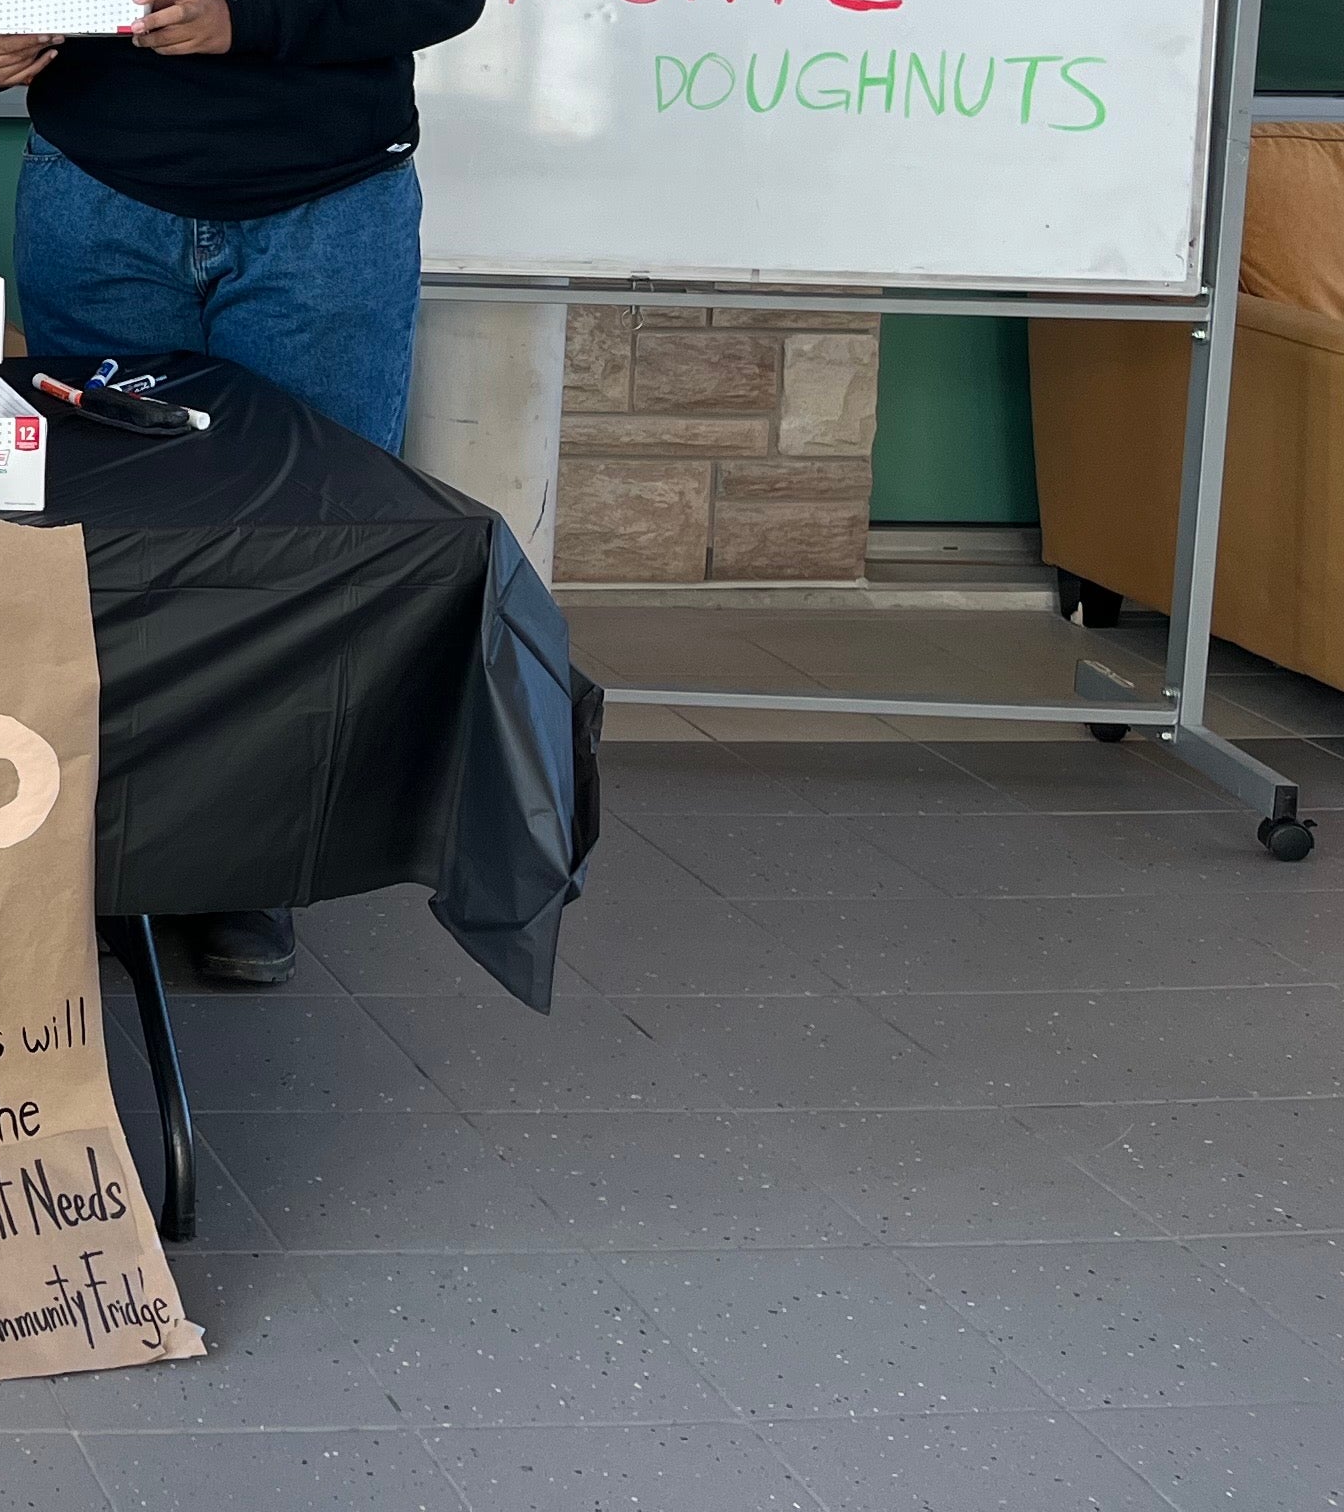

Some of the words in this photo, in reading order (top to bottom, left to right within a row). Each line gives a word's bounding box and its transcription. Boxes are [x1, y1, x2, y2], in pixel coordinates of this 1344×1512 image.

[654, 50, 1108, 132] DOUGHNUTS
[19, 427, 35, 440] 12
[22, 997, 87, 1054] will
[22, 1147, 126, 1235] Needs
